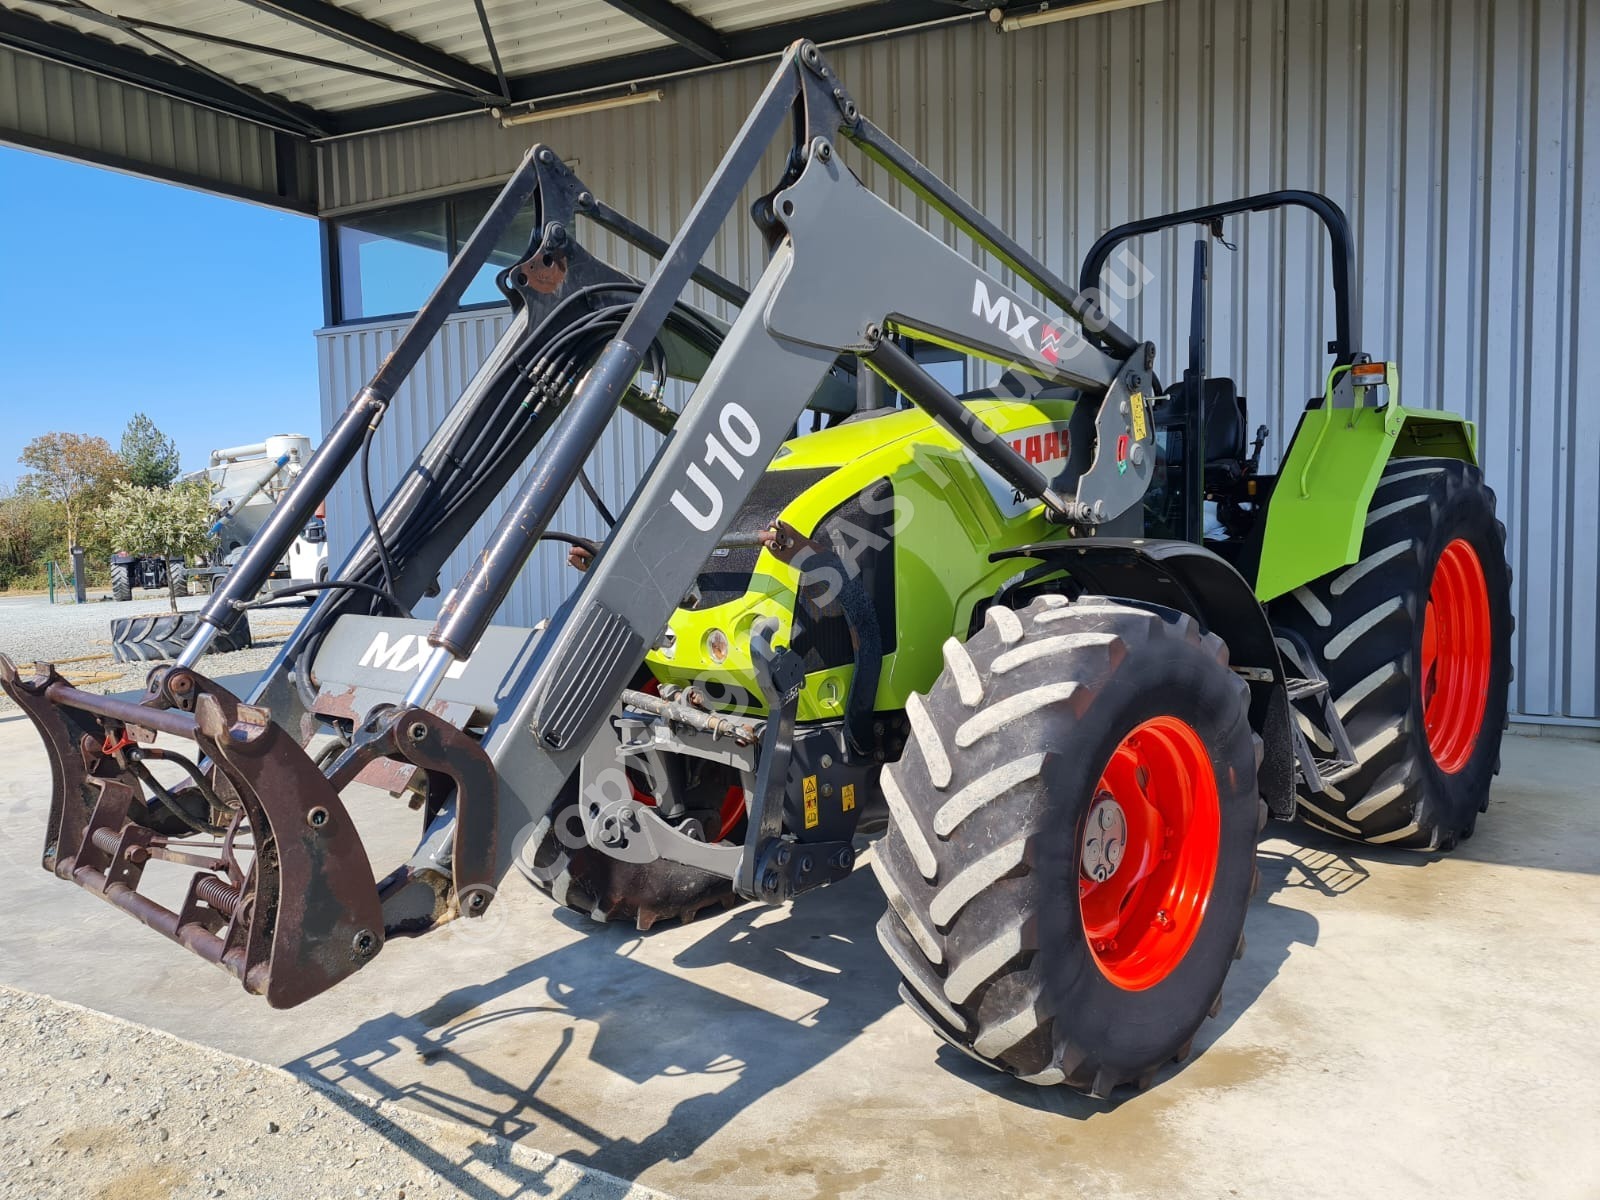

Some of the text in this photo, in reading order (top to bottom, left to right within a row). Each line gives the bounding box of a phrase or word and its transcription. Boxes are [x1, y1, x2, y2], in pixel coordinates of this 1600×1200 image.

[972, 278, 1040, 352] MX
[669, 402, 761, 532] U10
[1008, 428, 1069, 464] AAS
